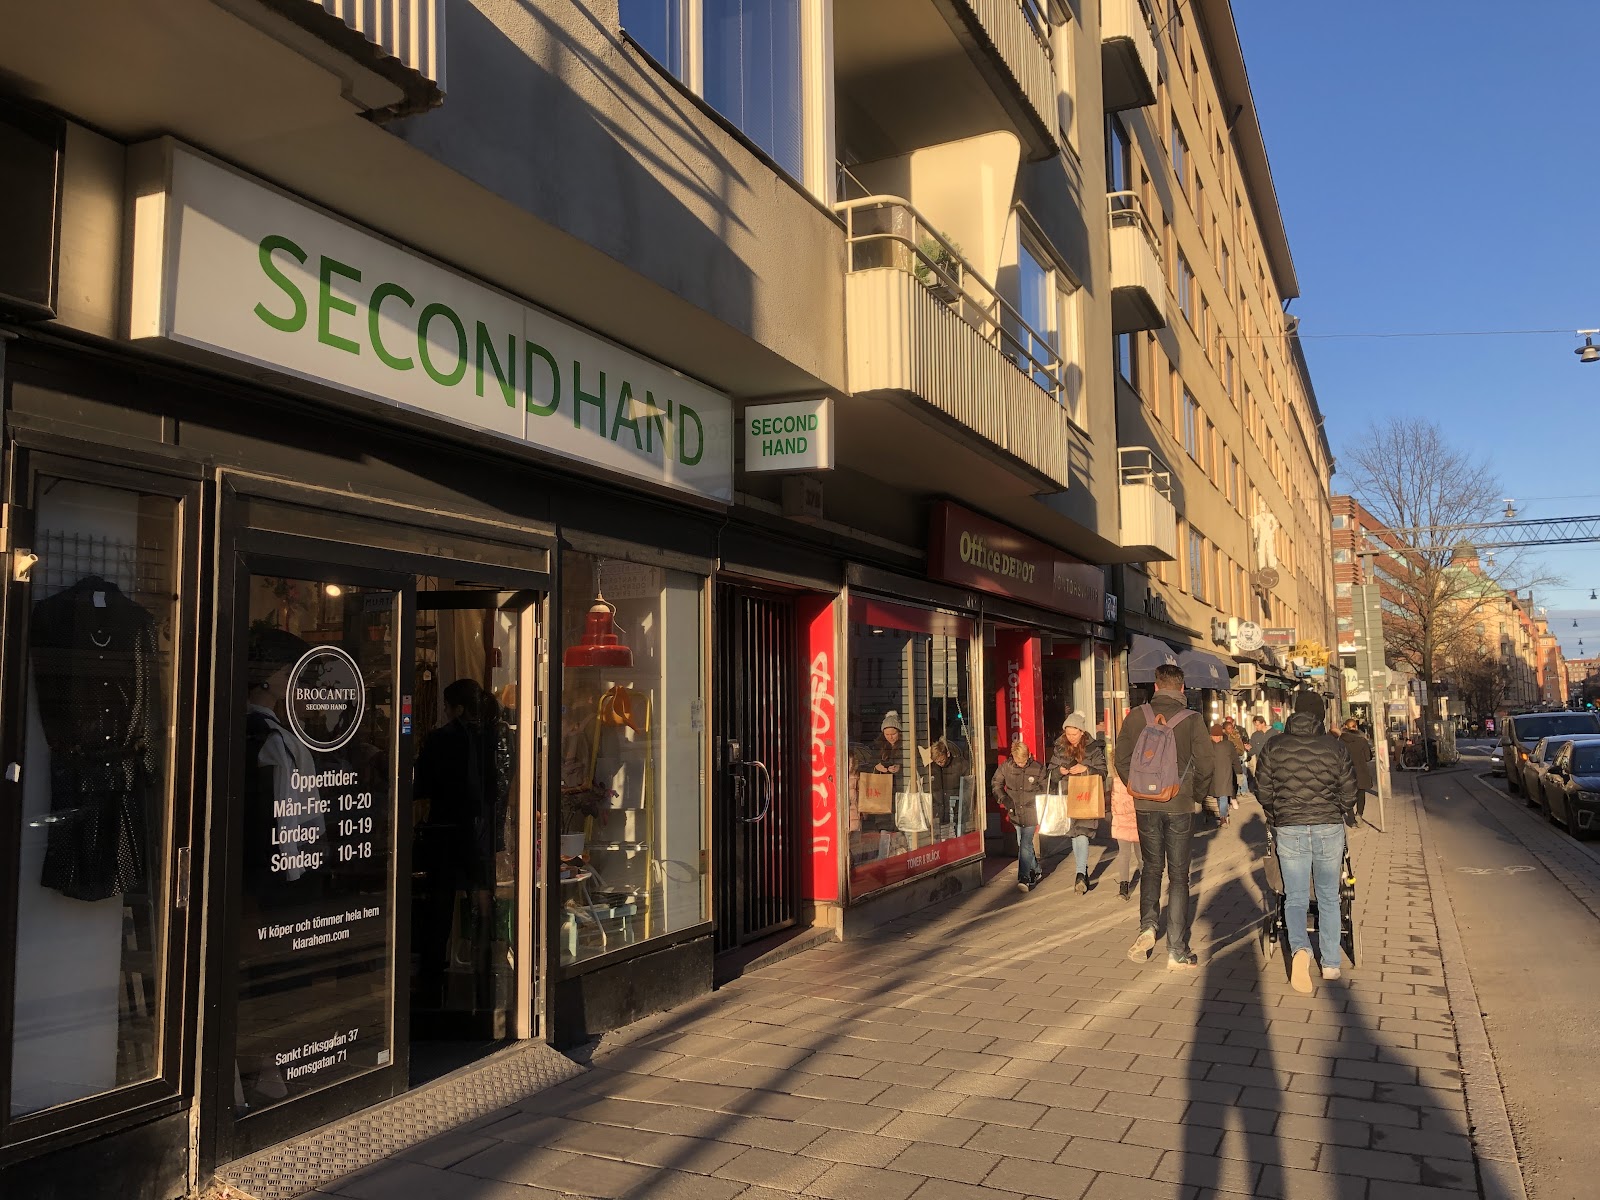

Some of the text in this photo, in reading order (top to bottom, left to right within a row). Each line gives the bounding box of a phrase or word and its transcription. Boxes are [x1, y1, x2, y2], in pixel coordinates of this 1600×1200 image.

[751, 413, 819, 436] SECOND
[762, 437, 808, 456] HAND
[296, 688, 356, 701] BROCANTE
[305, 703, 347, 711] SECOND HAND
[291, 769, 358, 792] Öppettider:
[273, 792, 372, 818] Mån-Fre: 10-20
[271, 817, 373, 845] Lördag: 10-19
[270, 842, 372, 872] Söndag: 10-18
[907, 856, 923, 870] TONER
[257, 906, 380, 940] Vi köper och tömmer hela hem
[292, 929, 350, 950] klarahem.com
[275, 1028, 359, 1066] Sankt Eriksgatan 37
[286, 1049, 347, 1080] Hornsgatan 71
